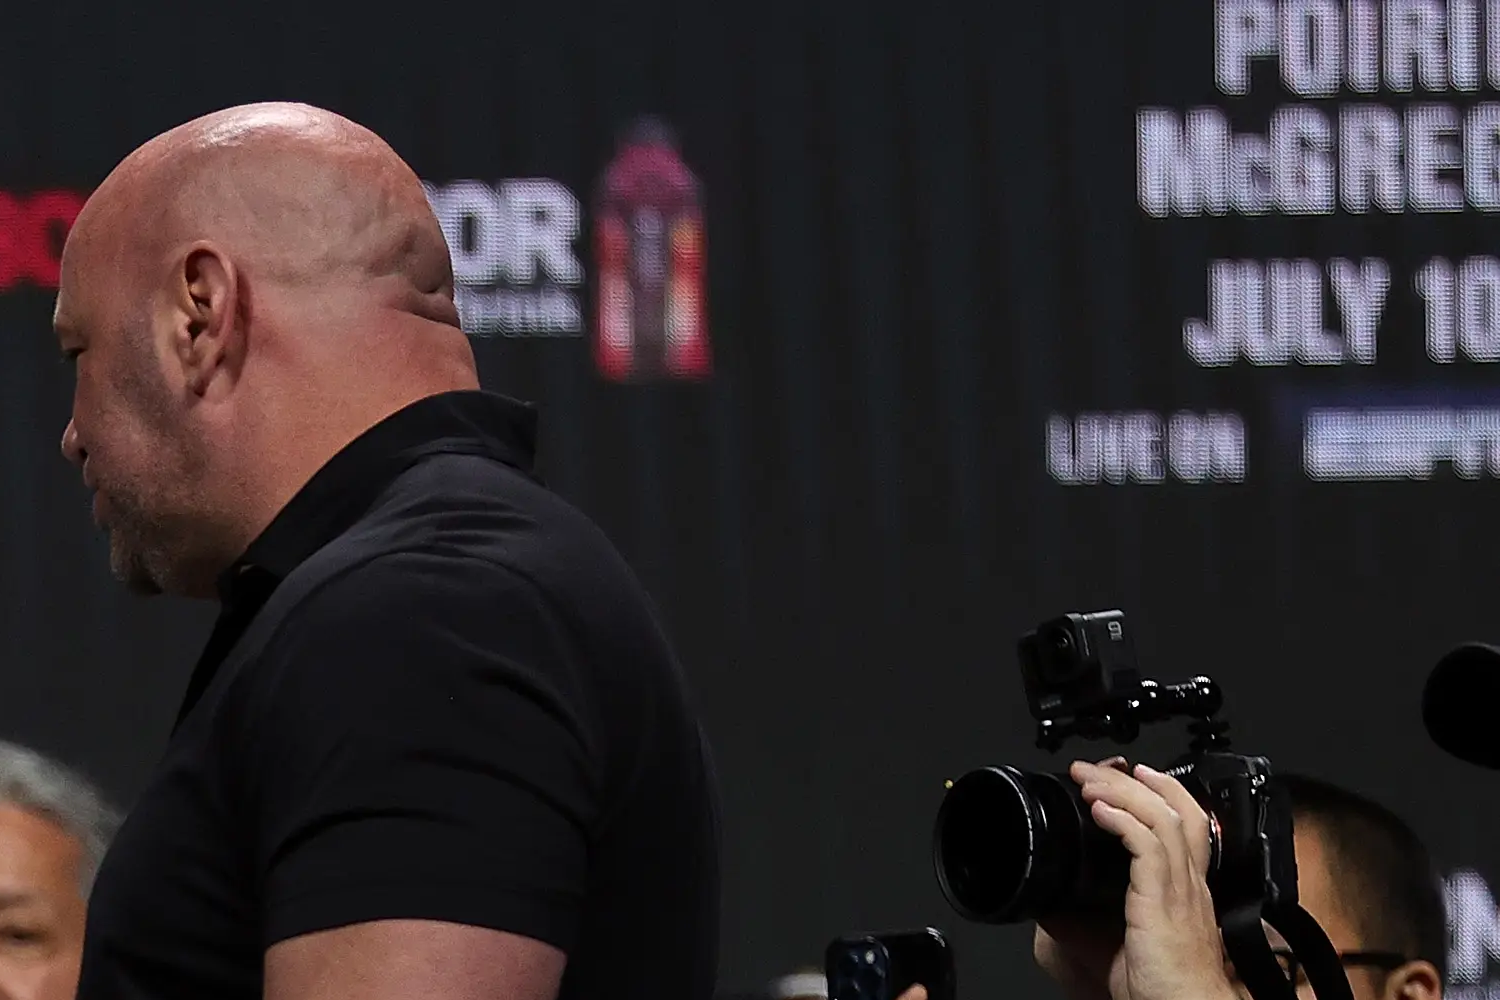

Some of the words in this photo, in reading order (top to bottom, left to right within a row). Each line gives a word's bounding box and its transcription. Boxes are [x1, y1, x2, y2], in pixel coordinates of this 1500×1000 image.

[1214, 0, 1500, 97] POIRI
[1182, 256, 1391, 367] JULY
[1167, 408, 1247, 485] ON
